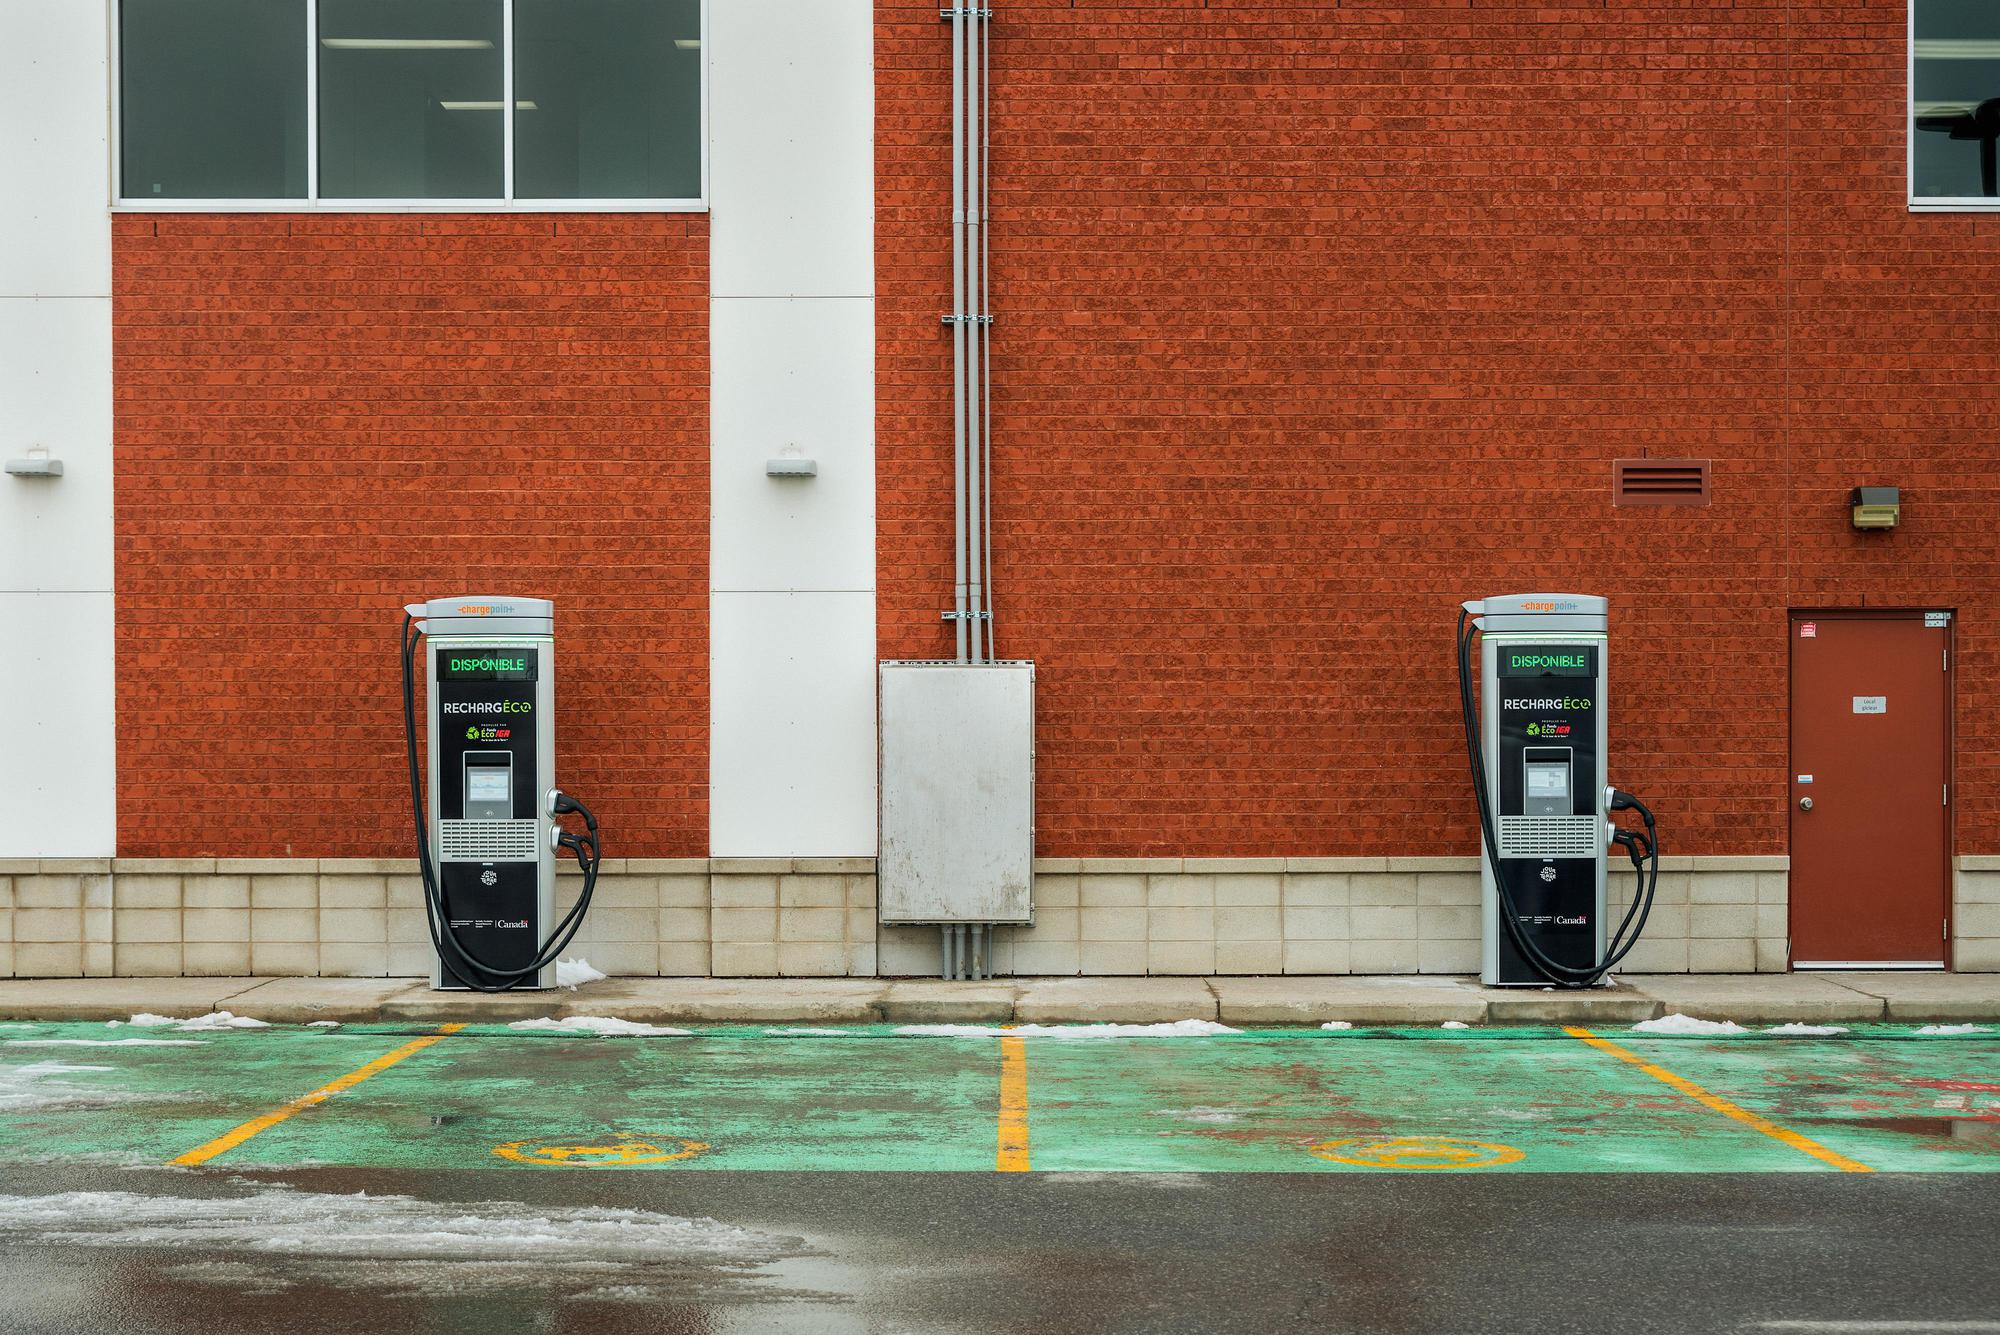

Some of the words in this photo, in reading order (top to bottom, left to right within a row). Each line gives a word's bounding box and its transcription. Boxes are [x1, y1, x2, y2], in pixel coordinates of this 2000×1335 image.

[451, 659, 525, 671] DISPONIBLE
[1512, 656, 1585, 667] DISPONIBLE
[495, 729, 511, 738] IGA
[1555, 725, 1571, 734] IGA
[497, 919, 528, 928] Canada
[1556, 915, 1586, 924] Canada
